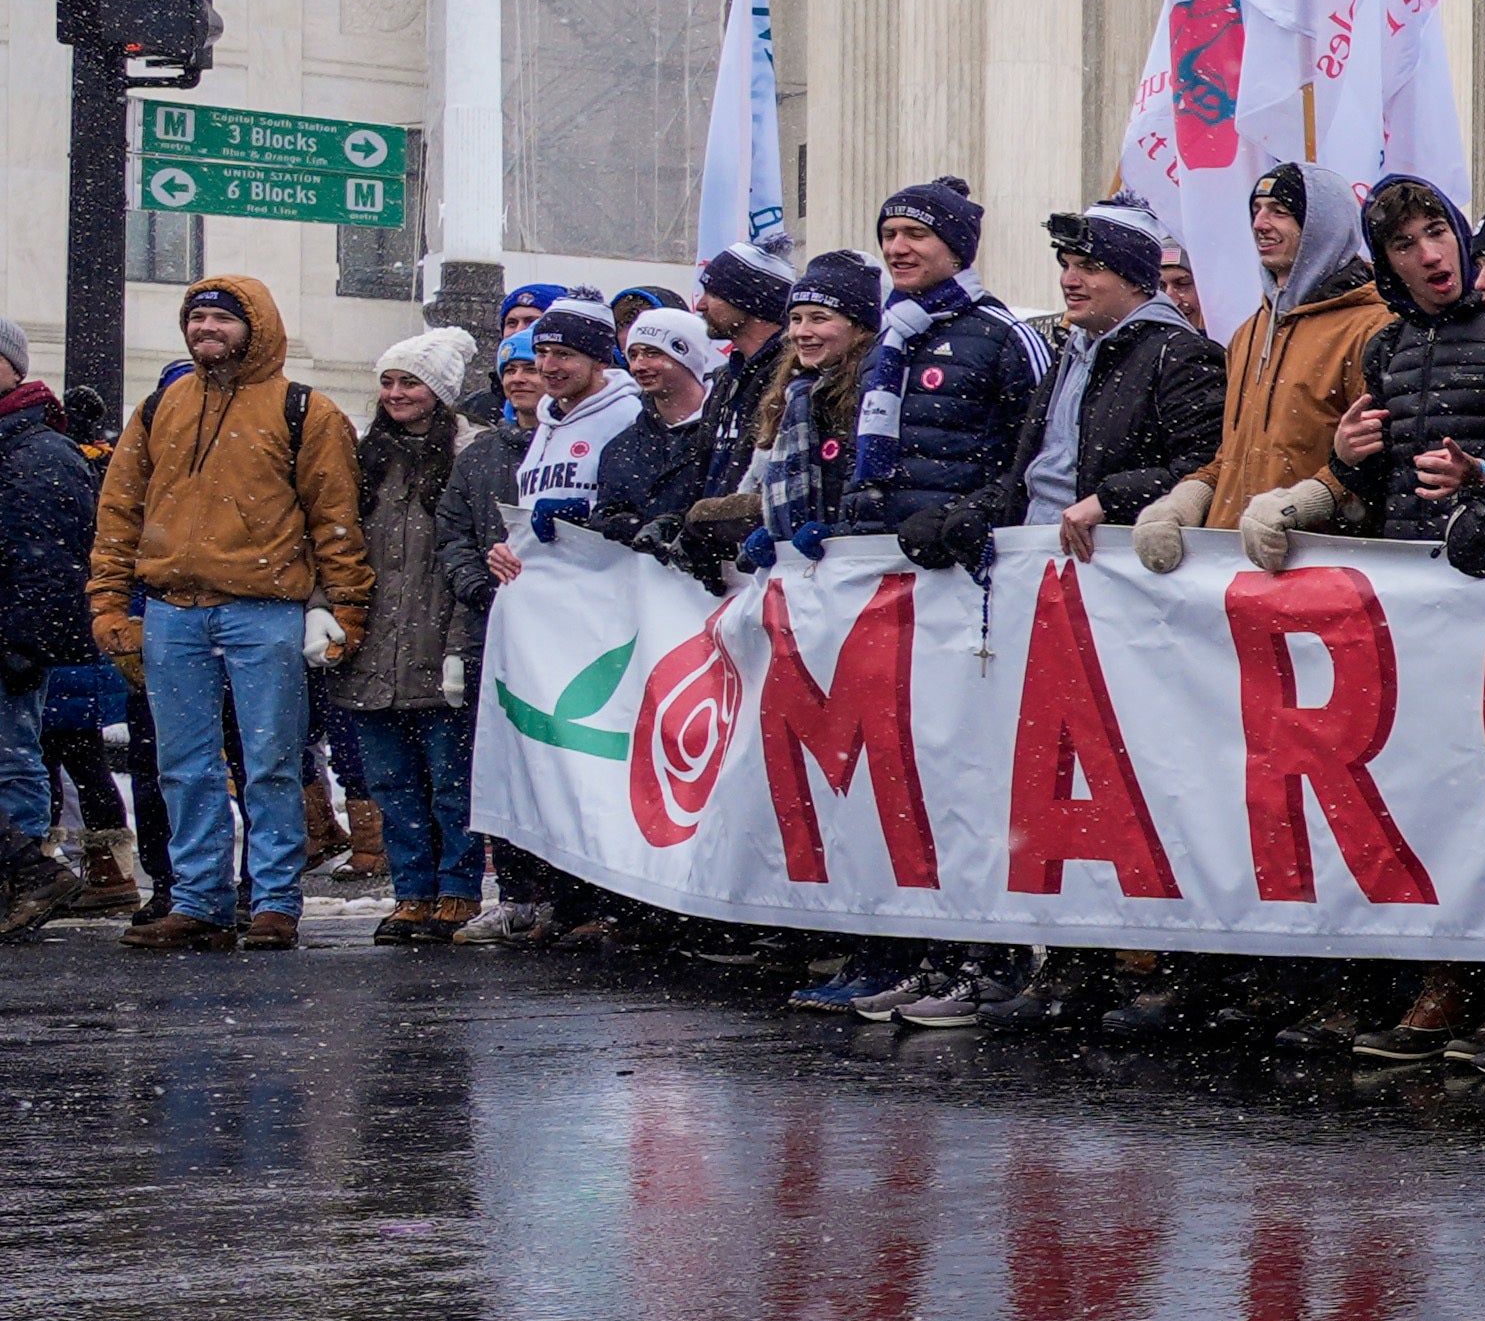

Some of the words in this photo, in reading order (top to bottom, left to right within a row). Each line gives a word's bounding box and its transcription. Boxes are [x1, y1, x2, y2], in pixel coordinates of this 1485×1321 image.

[259, 116, 293, 129] South
[297, 120, 338, 134] Station
[228, 124, 242, 145] 3
[251, 127, 318, 152] Blocks
[223, 167, 265, 180] UNION
[270, 171, 322, 184] STATION
[227, 180, 240, 199] 6
[251, 181, 318, 205] Blocks
[520, 469, 540, 497] WE
